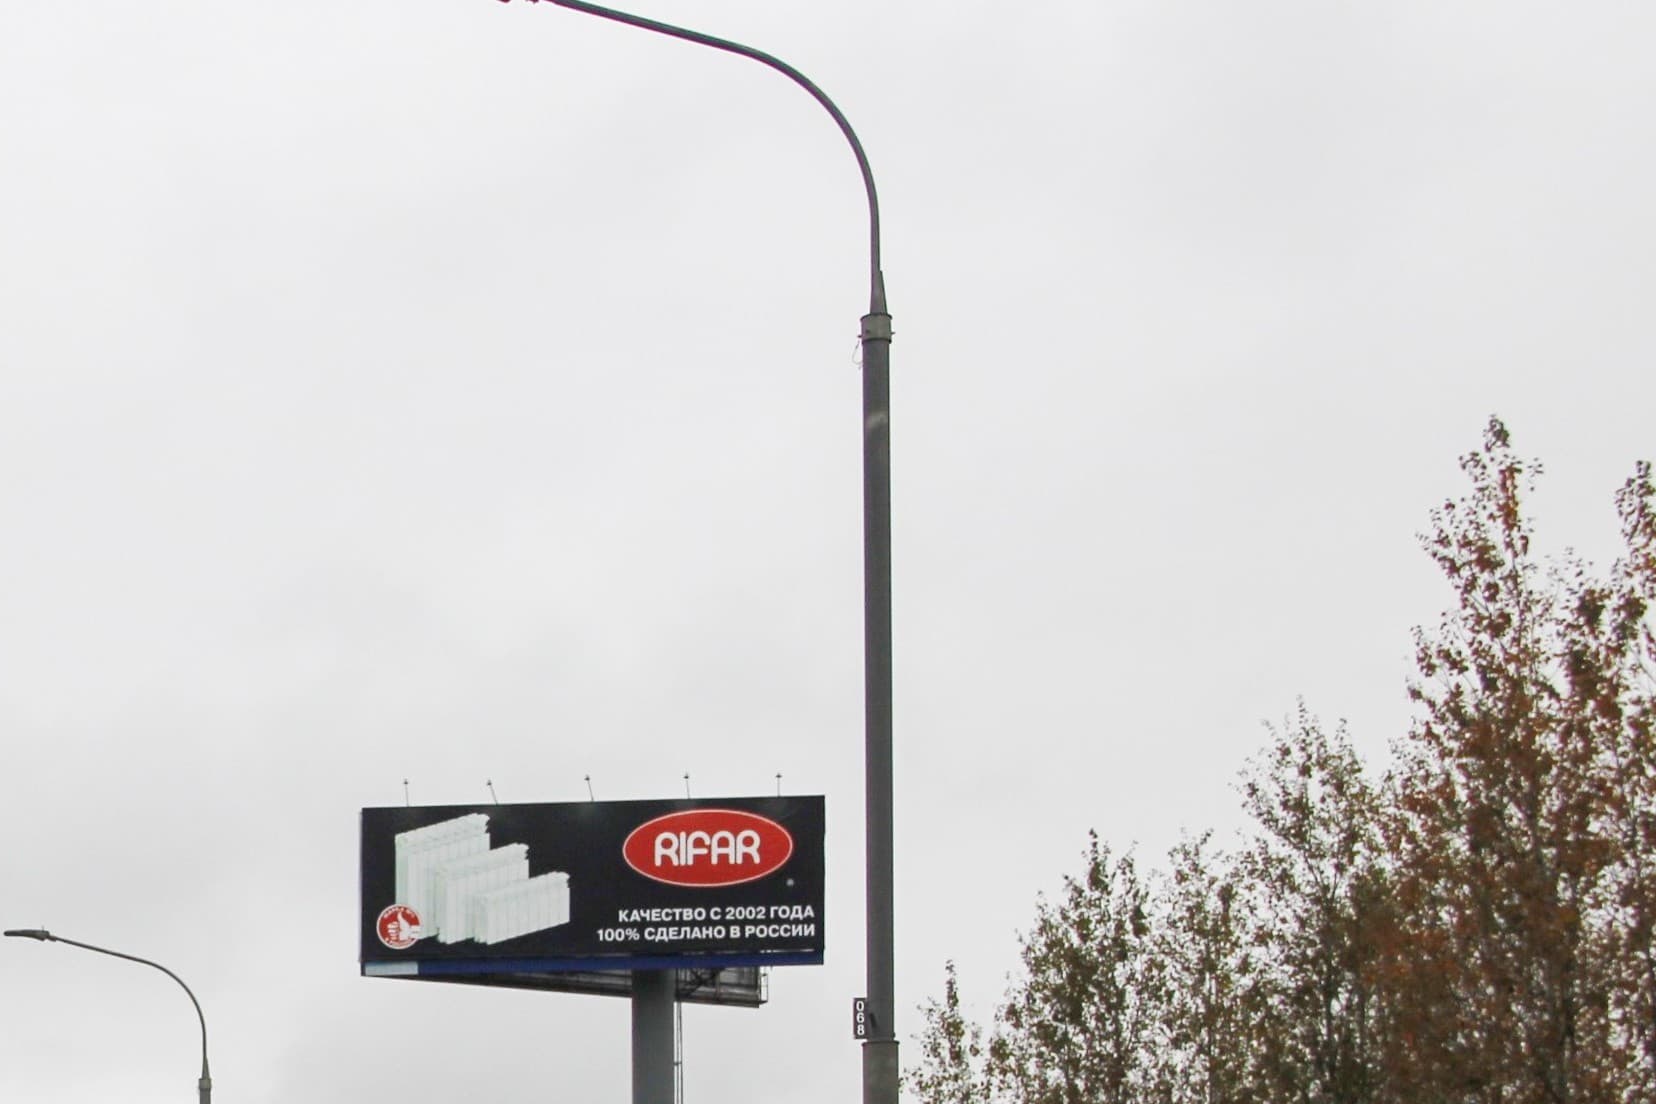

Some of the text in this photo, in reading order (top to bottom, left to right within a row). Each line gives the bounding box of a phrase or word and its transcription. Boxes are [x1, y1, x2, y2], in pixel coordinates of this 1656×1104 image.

[654, 830, 761, 867] RIFAR
[618, 907, 707, 922] КАЧЕСТВО
[725, 906, 766, 920] 2002
[769, 905, 815, 920] ГОДА
[597, 928, 640, 942] 100%
[644, 925, 726, 942] СДЕЛАНО
[744, 924, 816, 938] РОССИИ
[856, 1000, 865, 1036] 068
